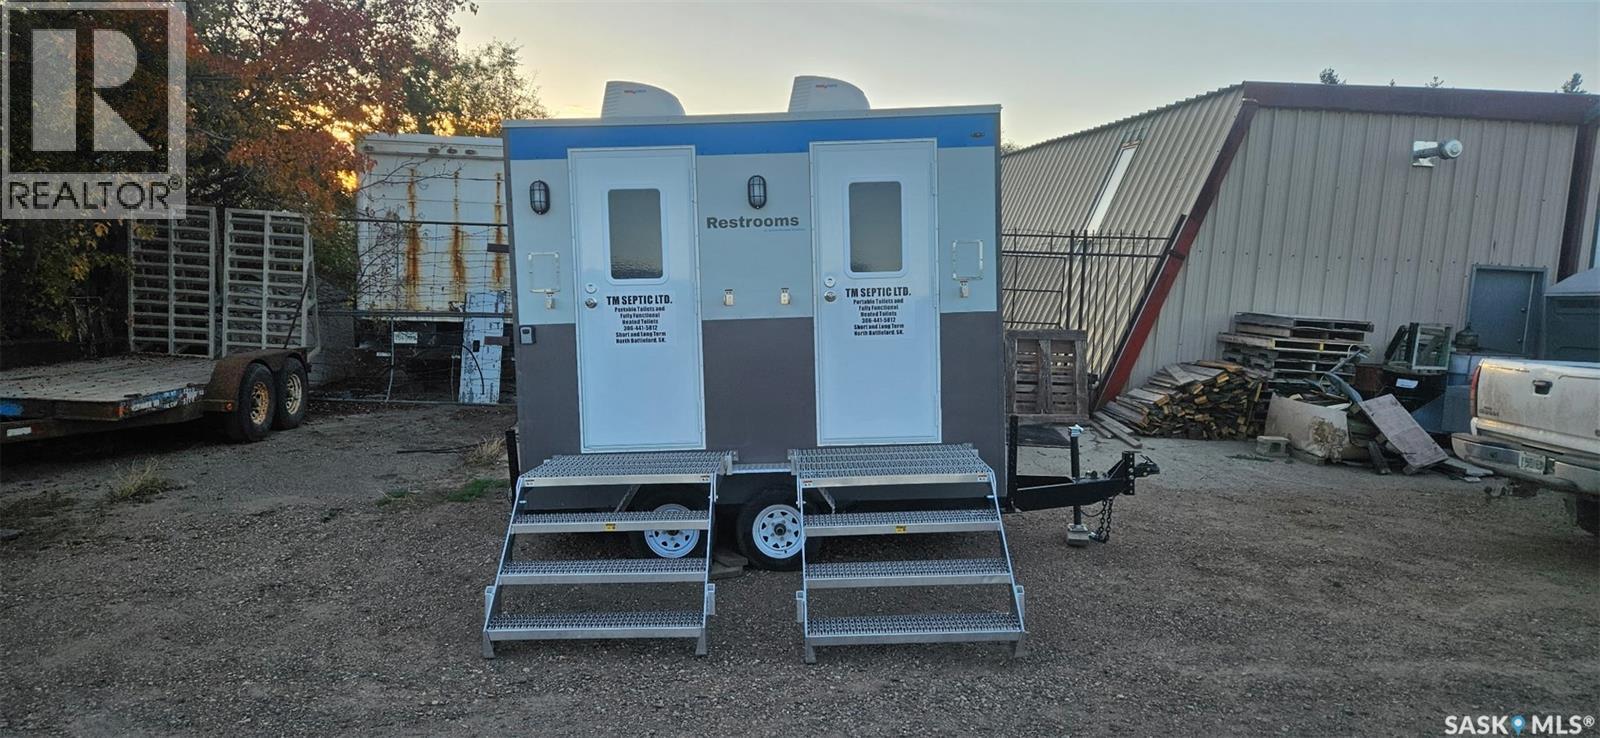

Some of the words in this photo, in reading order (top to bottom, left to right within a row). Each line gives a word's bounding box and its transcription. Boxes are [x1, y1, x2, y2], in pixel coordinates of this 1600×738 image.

[706, 216, 799, 229] Restrooms
[845, 288, 858, 298] TM
[860, 287, 892, 297] SEPTIC
[894, 287, 911, 296] LTD.
[606, 296, 620, 305] TM
[622, 295, 653, 305] SEPTIC
[655, 295, 672, 304] LTD.
